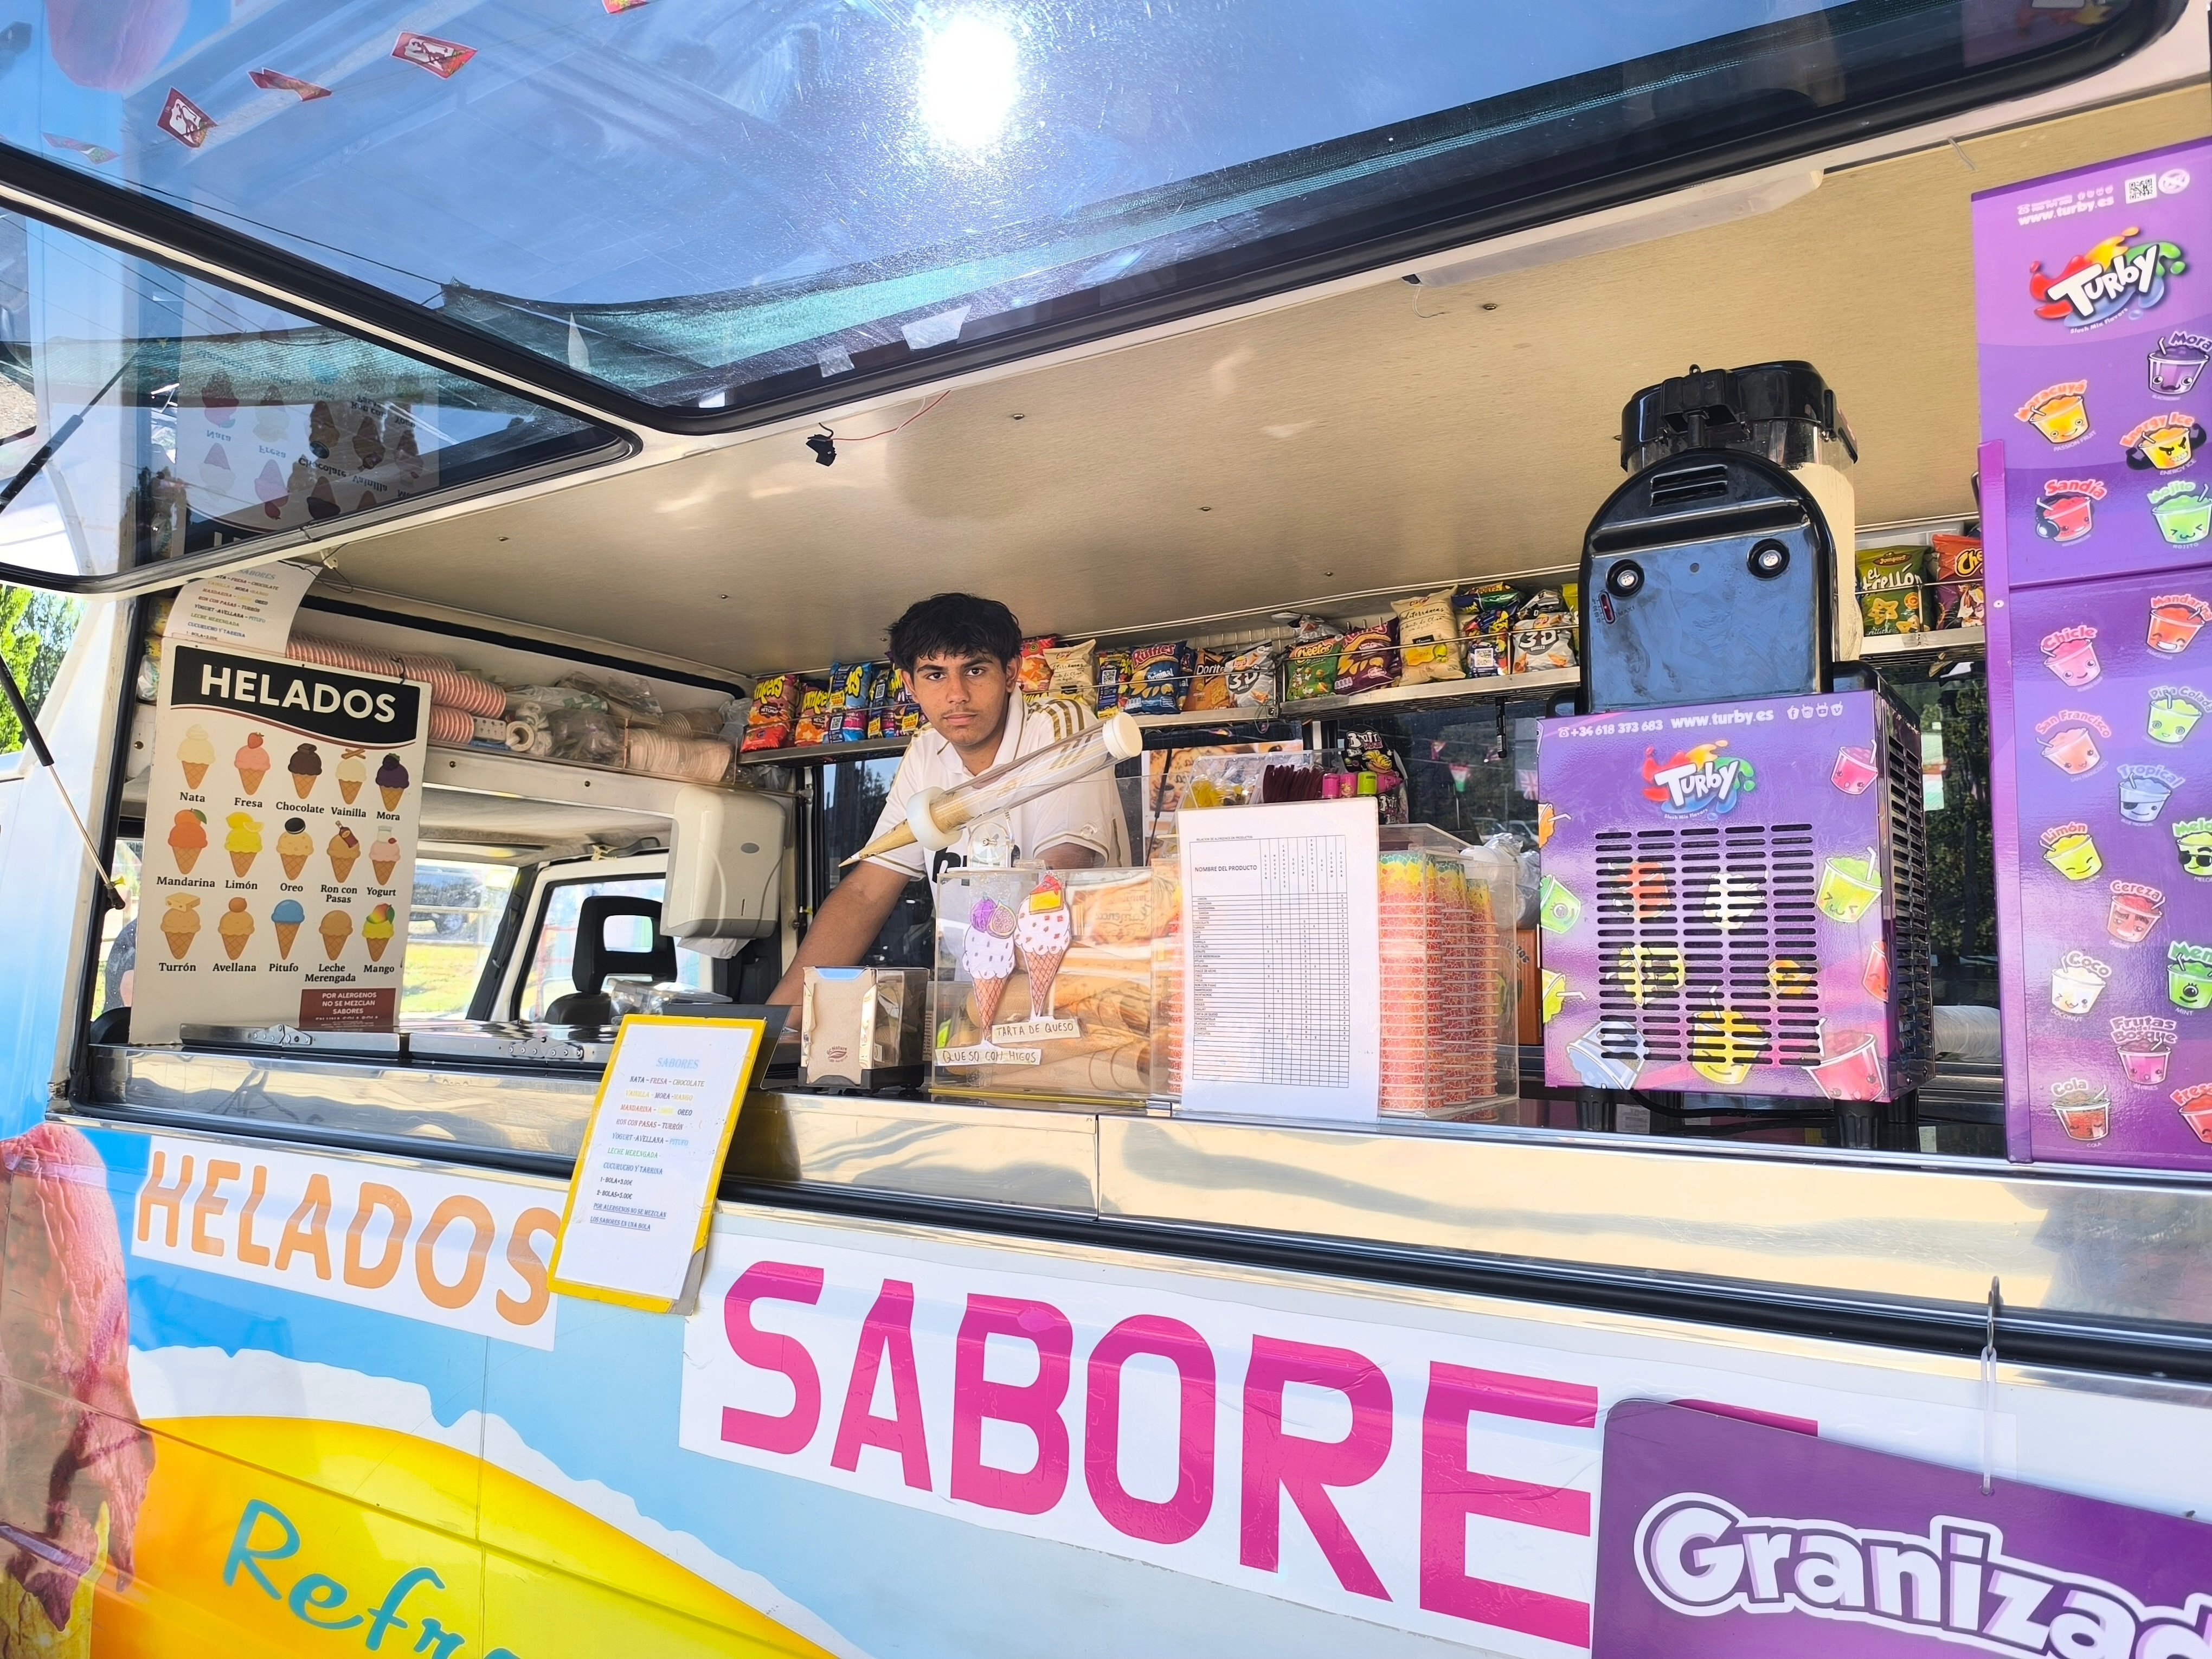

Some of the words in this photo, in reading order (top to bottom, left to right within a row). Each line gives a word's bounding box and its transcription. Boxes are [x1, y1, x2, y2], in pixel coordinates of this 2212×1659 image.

[2017, 196, 2114, 226] www.turby.es
[2170, 331, 2212, 351] Mora
[2169, 411, 2195, 427] Ice
[2054, 440, 2080, 452] PASSION
[2080, 430, 2096, 443] FRUIT
[2160, 465, 2185, 475] ENERGY
[2186, 459, 2197, 468] ICE
[2044, 479, 2107, 500] Sandía
[2147, 480, 2196, 504] Mojito
[2041, 625, 2098, 651] Chicle
[201, 664, 396, 724] HELADOS
[1571, 726, 1593, 737] +34
[1595, 724, 1615, 736] 618
[1618, 722, 1639, 734] 373
[1641, 720, 1663, 731] 683
[1670, 709, 1774, 729] www.turby.es
[2035, 716, 2059, 735] San
[2059, 710, 2111, 738] Francisco
[2117, 764, 2185, 788] Tropical
[179, 792, 205, 803] Nata
[234, 797, 263, 808] Fresa
[275, 801, 325, 814] Chocolate
[331, 807, 366, 818] Vainilla
[1689, 808, 1708, 818] Flavors
[376, 811, 401, 821] Mora
[2041, 821, 2088, 844] Limón
[2172, 818, 2212, 837] Melo
[156, 876, 216, 889] Mandarina
[225, 880, 258, 890] Limón
[280, 883, 304, 893] Oreo
[320, 884, 339, 894] Ron
[341, 886, 358, 895] con
[366, 886, 396, 898] Yogurt
[2110, 880, 2162, 902] Cereza
[326, 894, 352, 904] Pasas
[2168, 941, 2212, 964] Men
[159, 962, 196, 972] Turrón
[213, 962, 256, 972] Avellana
[269, 963, 299, 972] Pitufo
[319, 963, 345, 972] Leche
[363, 964, 395, 974] Mango
[2066, 950, 2112, 978] Coco
[305, 974, 356, 984] Merengada
[2050, 1007, 2083, 1023] COCONUT
[2175, 1007, 2193, 1016] MINT
[2110, 1015, 2177, 1030] Frutas
[996, 1026, 1025, 1037] TARTA
[1029, 1025, 1039, 1034] DE
[1045, 1023, 1073, 1033] QUESO
[656, 1057, 699, 1069] SABORES
[943, 1050, 979, 1063] QUESO
[985, 1051, 1002, 1061] CON
[1009, 1051, 1036, 1063] HIGOS
[673, 1079, 705, 1087] CHOCOLATE
[2051, 1077, 2088, 1097] Cola
[620, 1104, 652, 1113] MANDARINA
[638, 1120, 657, 1128] PASAS
[662, 1122, 684, 1130] TURRÓN
[613, 1133, 633, 1141] YOGURT
[608, 1147, 625, 1155] LECHE
[625, 1149, 658, 1159] MERENGADA
[603, 1162, 634, 1172] CUCURUCHO
[640, 1166, 663, 1175] TARRINA
[603, 1204, 629, 1213] ALERGENOS
[644, 1209, 667, 1218] MEZCLAN
[599, 1217, 620, 1225] SABORES
[137, 1150, 562, 1326] HELADOS
[721, 1260, 1818, 1649] SABORE
[222, 1499, 522, 1659] Refr
